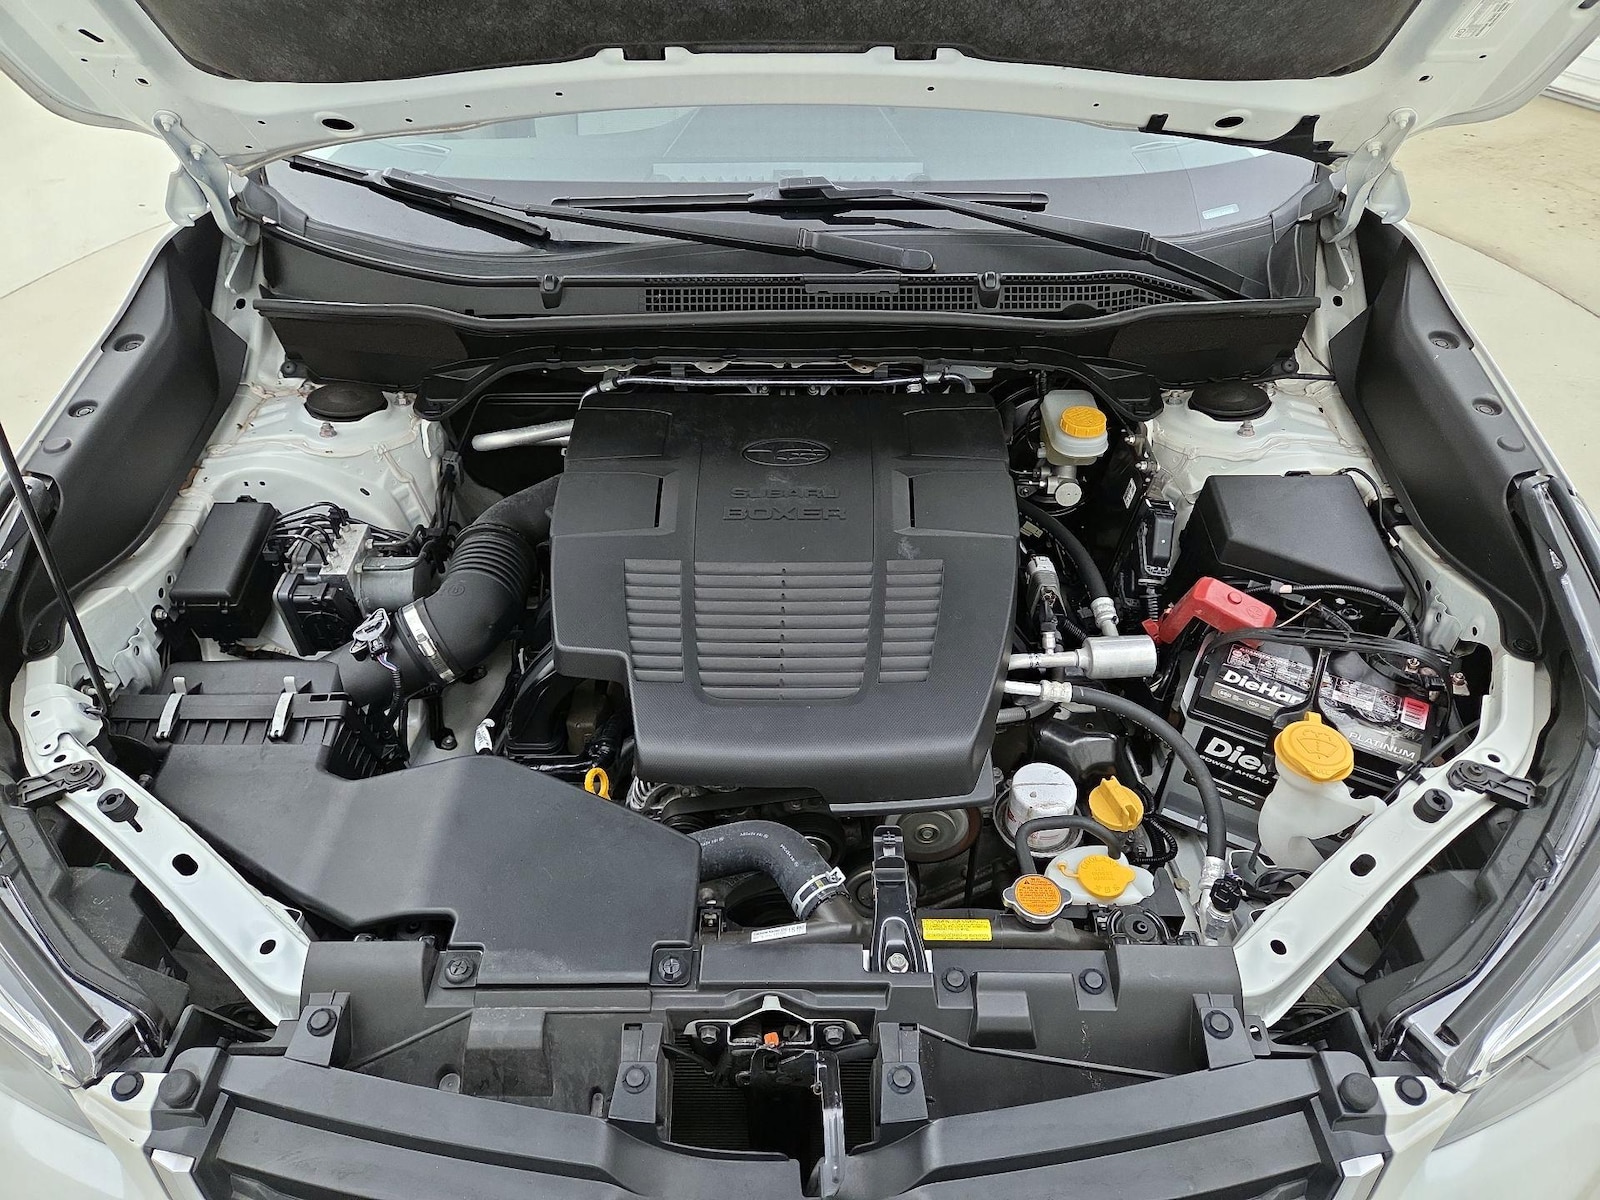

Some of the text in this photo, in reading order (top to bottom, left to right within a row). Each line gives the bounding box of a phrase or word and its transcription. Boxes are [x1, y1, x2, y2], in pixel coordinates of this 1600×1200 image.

[730, 487, 840, 498] SUBARU
[723, 506, 847, 520] BOXER
[1223, 670, 1303, 704] DieHar
[1204, 737, 1267, 775] Die
[1349, 732, 1416, 759] PLATINUM
[1235, 769, 1270, 785] AHEAD
